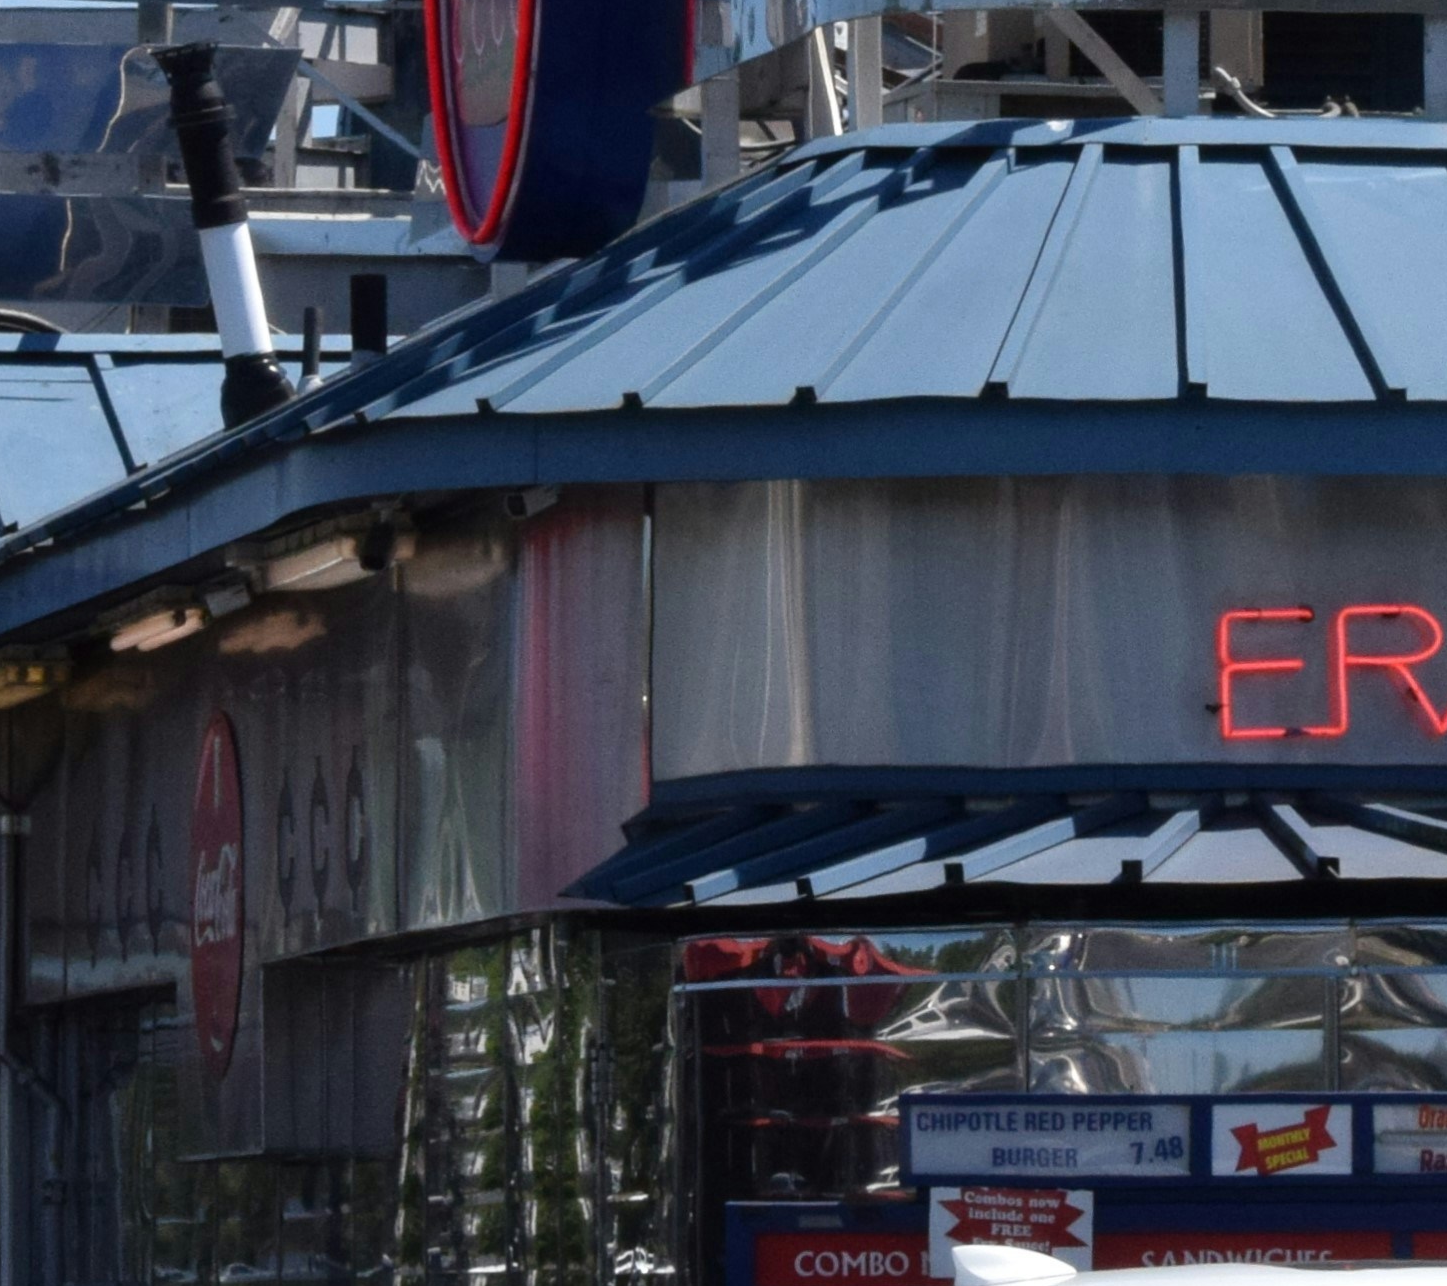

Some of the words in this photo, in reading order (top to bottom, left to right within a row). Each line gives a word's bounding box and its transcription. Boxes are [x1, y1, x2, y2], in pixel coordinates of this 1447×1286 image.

[915, 1111, 1018, 1132] CHIPOTLE
[1024, 1111, 1066, 1132] RED
[1072, 1111, 1153, 1132] PEPPER
[992, 1146, 1079, 1168] BURGER
[1129, 1135, 1185, 1166] 7.48
[1265, 1148, 1310, 1170] SPECIAL
[964, 1191, 1023, 1207] Combos
[1029, 1197, 1061, 1209] now
[968, 1207, 1024, 1223] include
[1029, 1213, 1056, 1224] one
[990, 1223, 1032, 1236] FREE
[794, 1251, 910, 1277] COMBO
